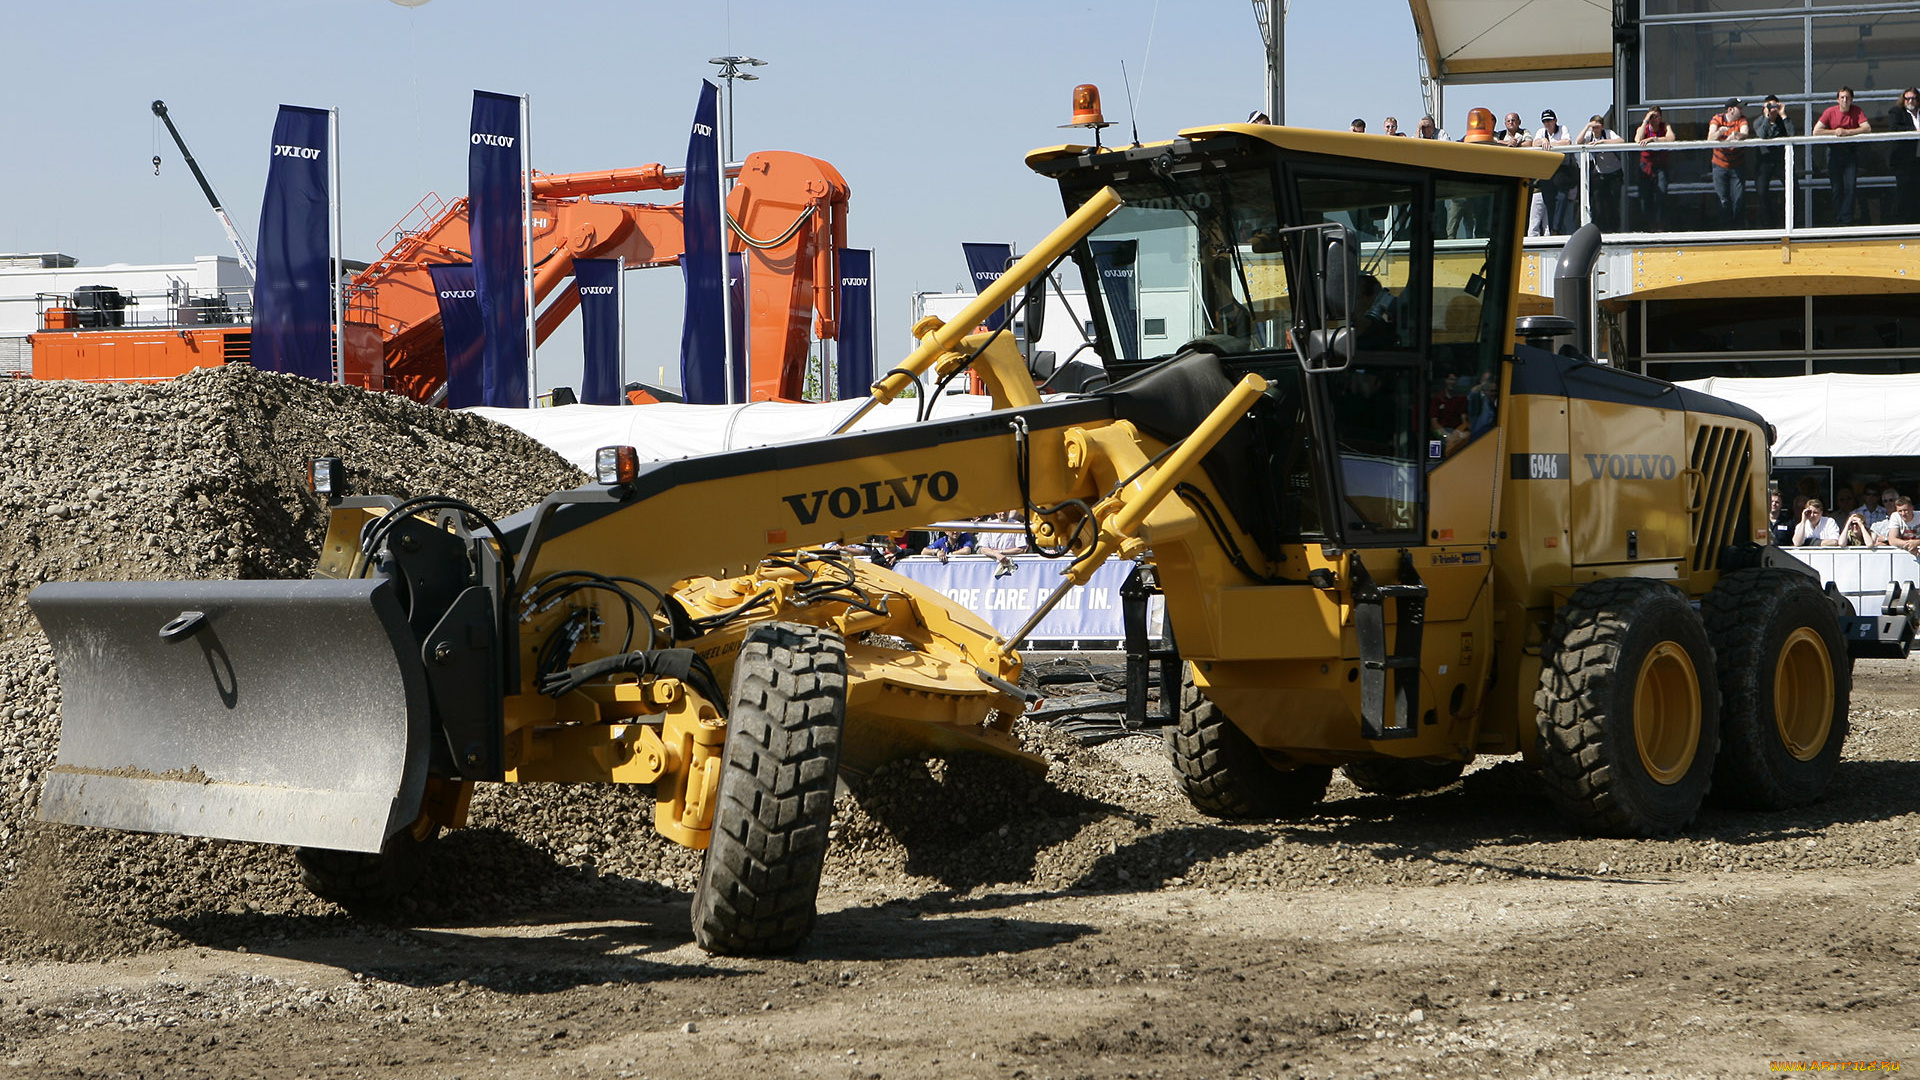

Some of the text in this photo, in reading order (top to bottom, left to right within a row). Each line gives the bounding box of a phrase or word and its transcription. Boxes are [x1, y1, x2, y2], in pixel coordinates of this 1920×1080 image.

[1530, 454, 1557, 479] G946
[1584, 453, 1676, 480] VOLVO
[782, 470, 959, 526] VOLVO
[985, 588, 1032, 611] CARE.
[1087, 587, 1112, 610] IN.
